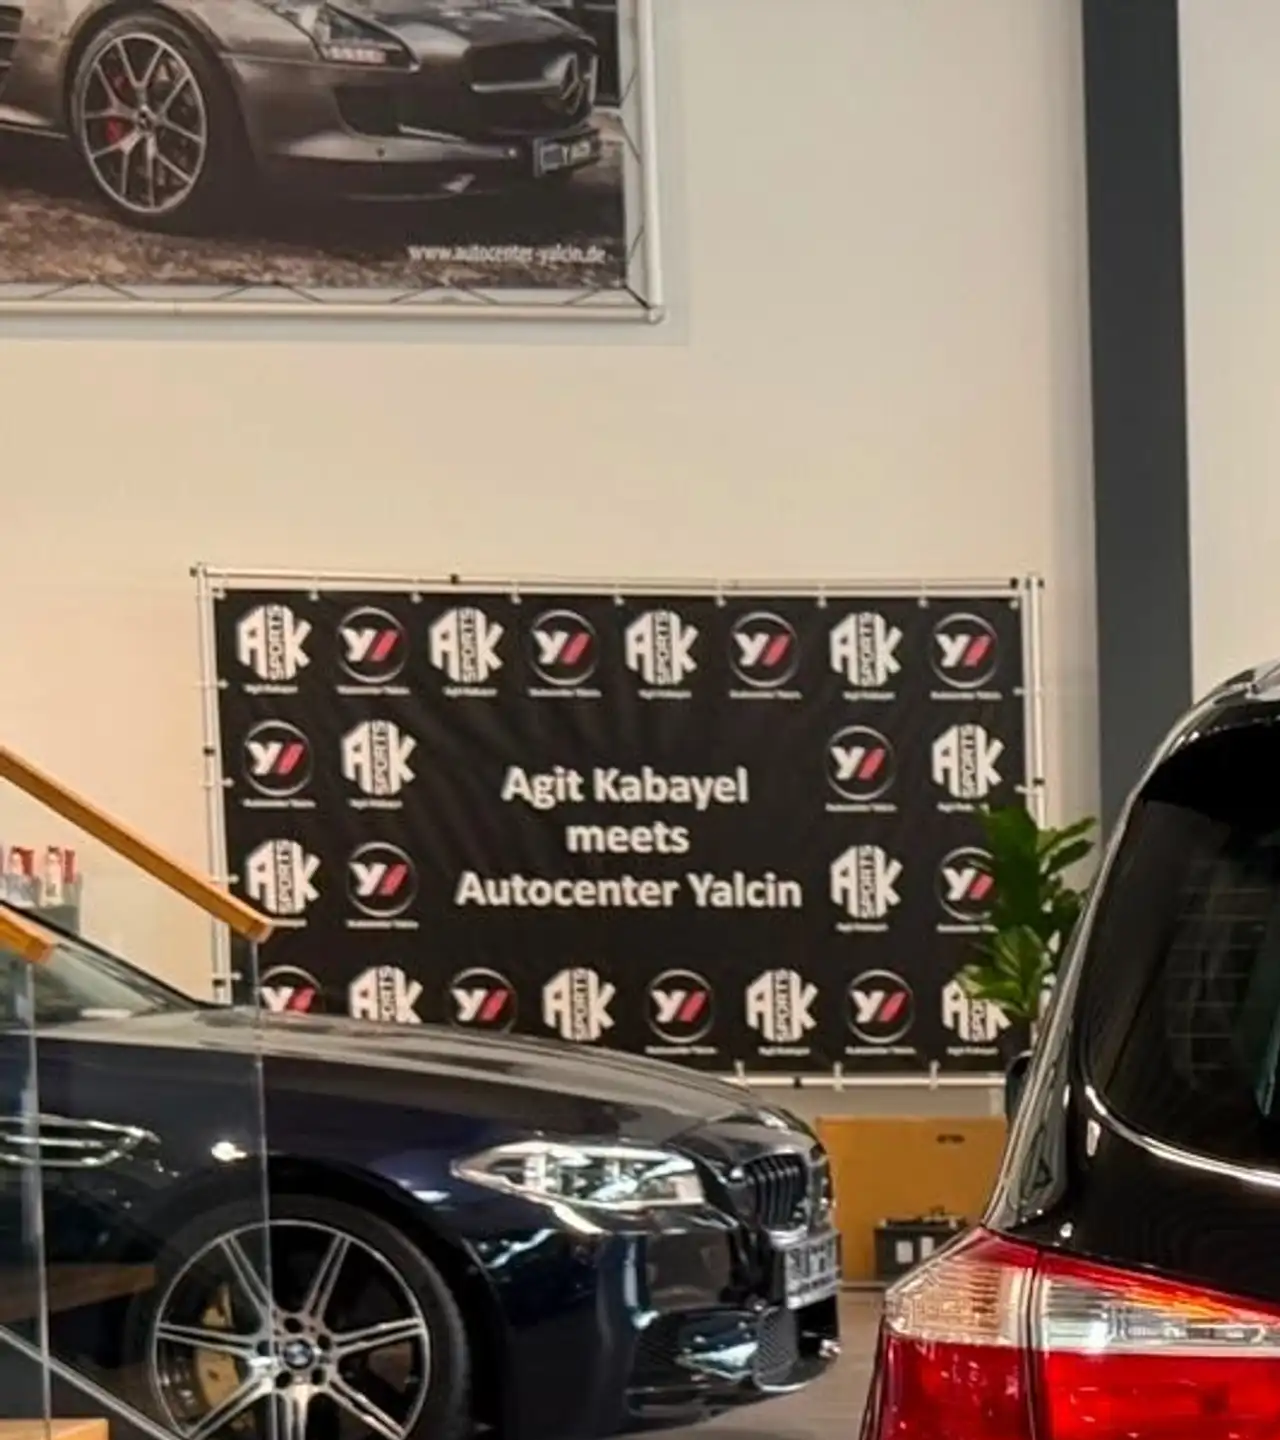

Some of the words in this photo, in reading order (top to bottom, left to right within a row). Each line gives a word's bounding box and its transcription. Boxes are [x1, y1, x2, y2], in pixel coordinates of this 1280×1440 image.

[501, 766, 584, 810] Agit
[594, 766, 748, 811] Kabayel
[566, 821, 690, 854] meets
[456, 870, 680, 909] Autocenter
[686, 869, 802, 908] Yalcin
